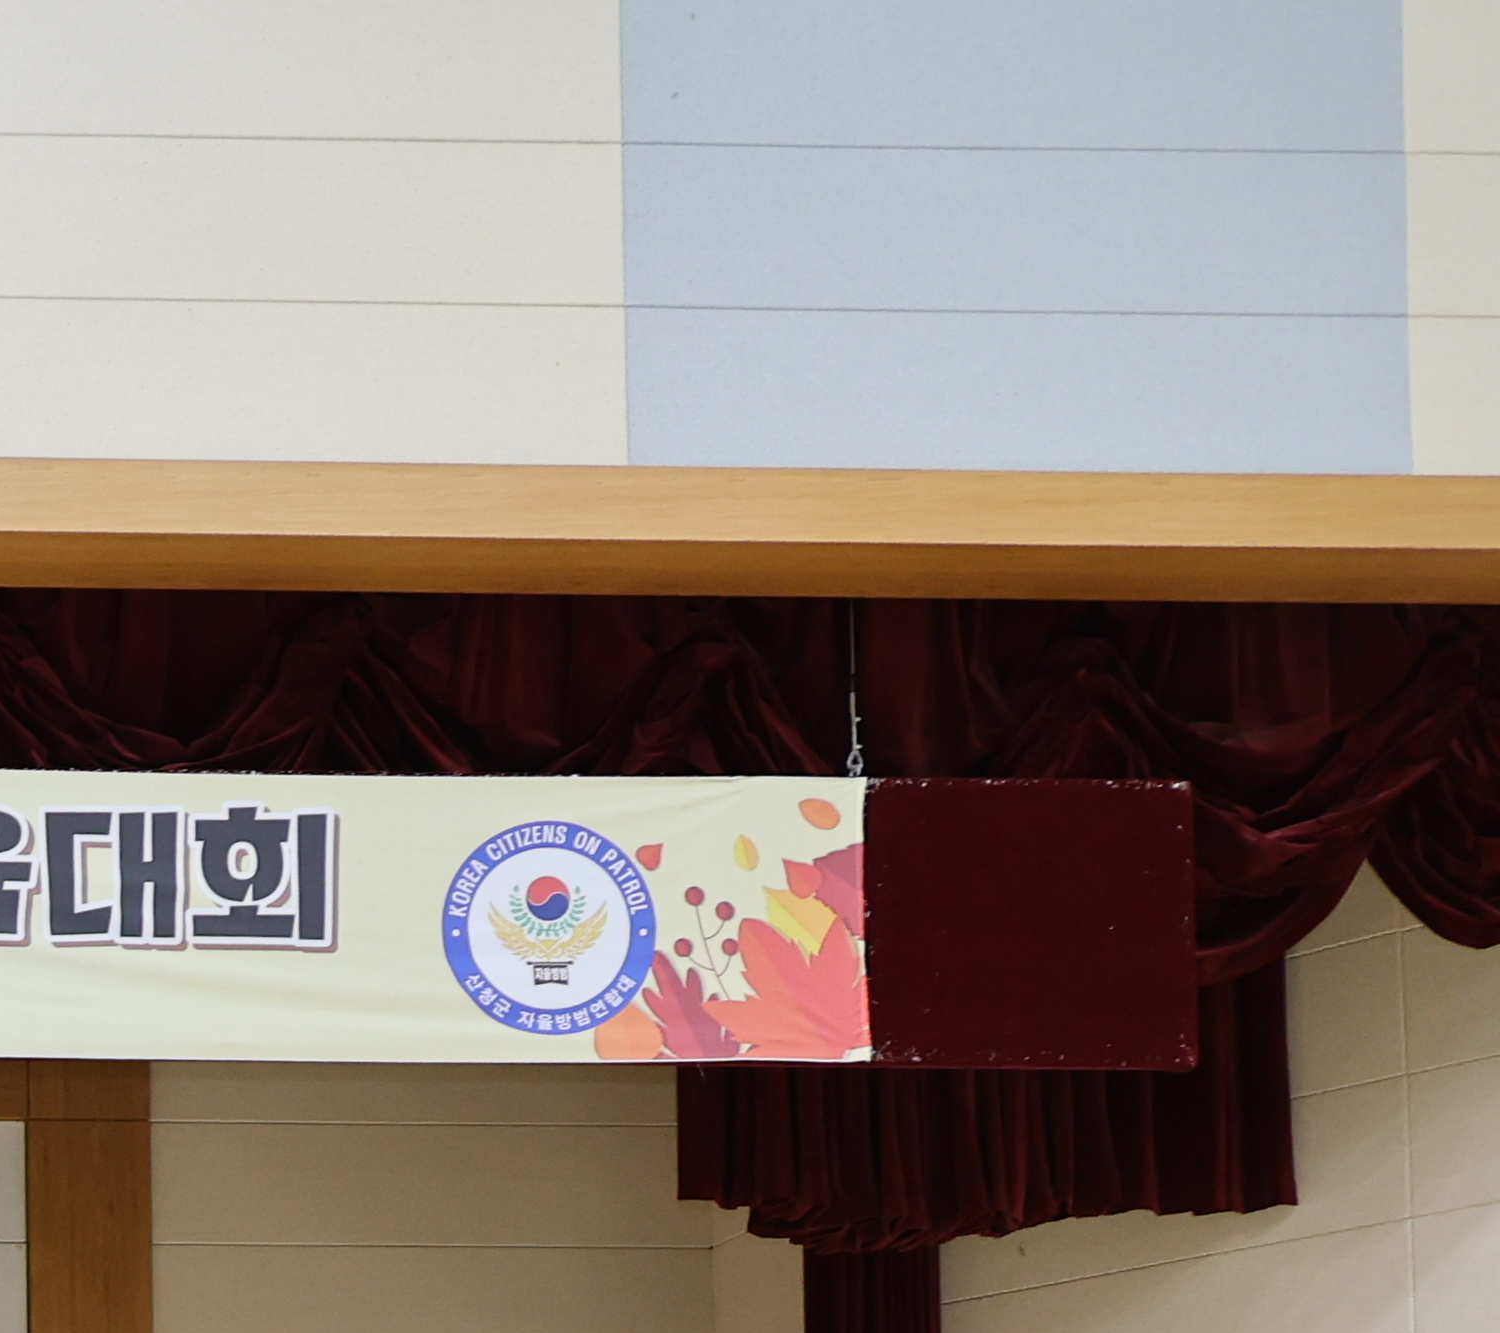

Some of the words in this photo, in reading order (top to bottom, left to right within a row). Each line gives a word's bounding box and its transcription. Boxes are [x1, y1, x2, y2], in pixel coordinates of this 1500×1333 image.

[448, 859, 489, 917] KOREA
[486, 825, 567, 861] CITIZENS
[573, 831, 601, 855] ON
[600, 849, 649, 915] PATROL
[465, 974, 513, 1018] 산청군
[517, 975, 637, 1031] 자율방범연합대
